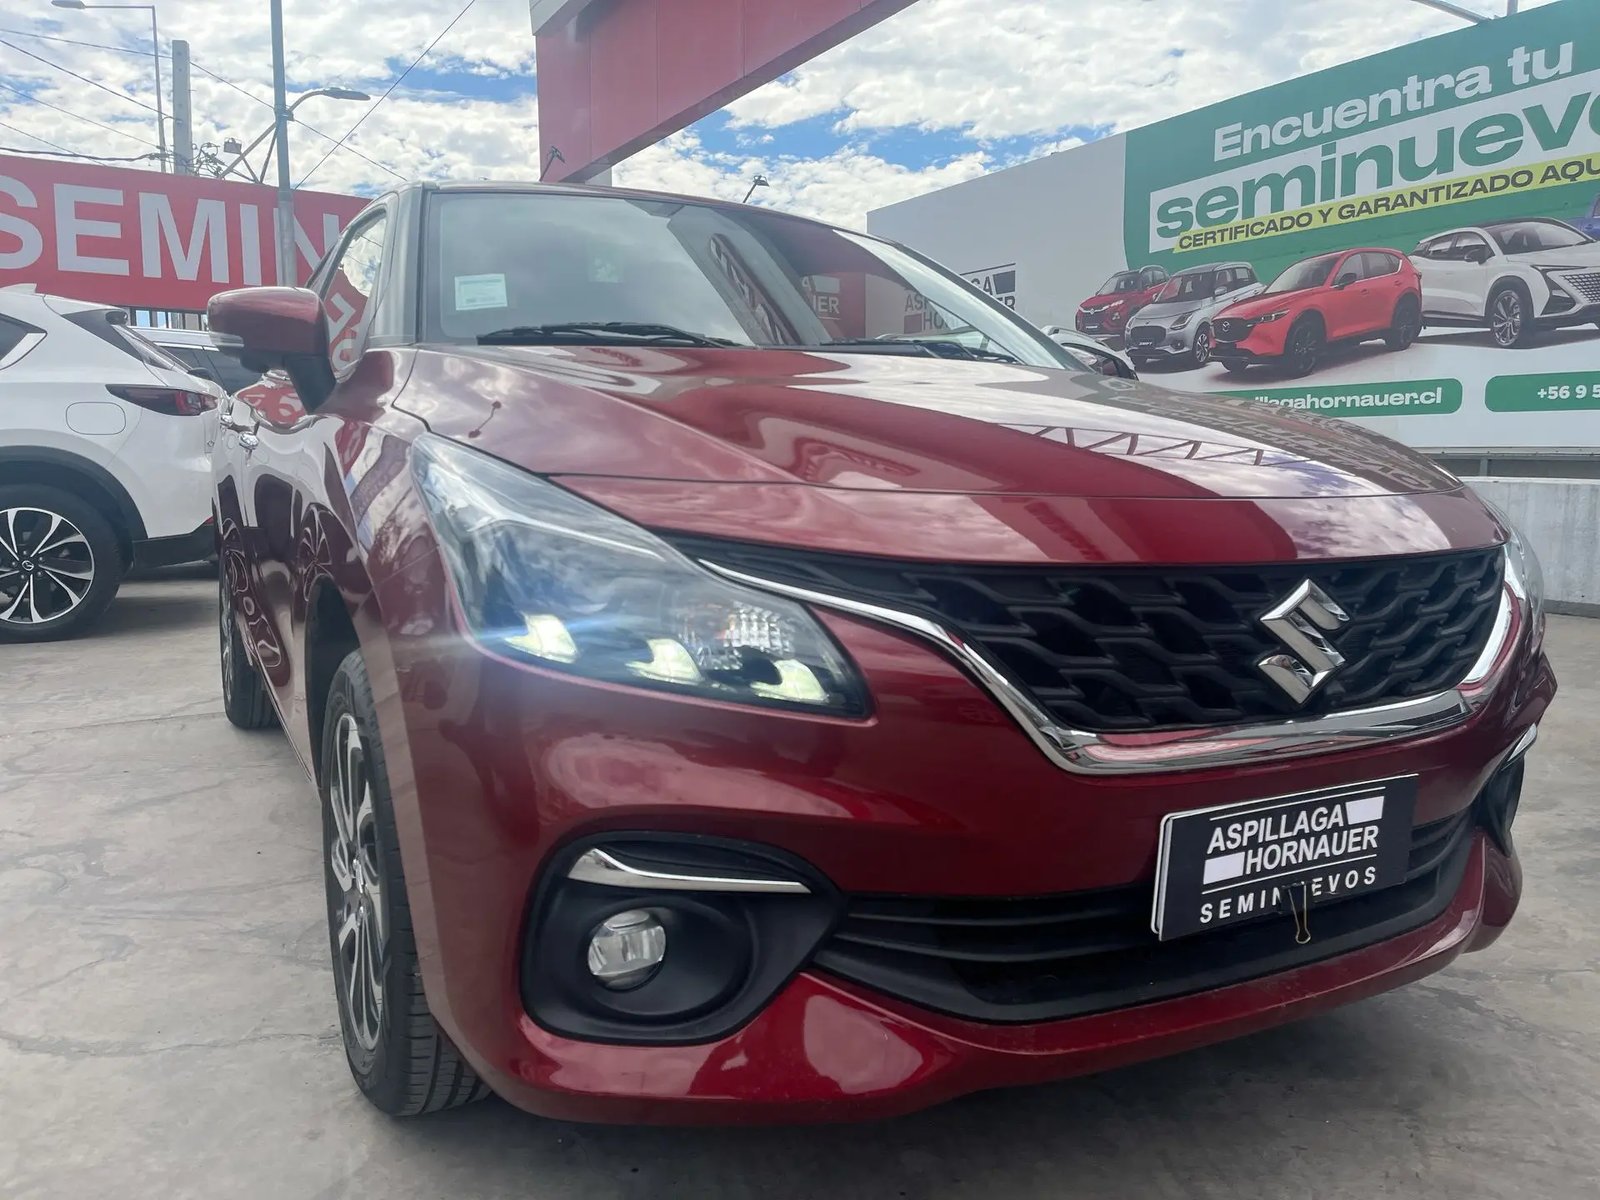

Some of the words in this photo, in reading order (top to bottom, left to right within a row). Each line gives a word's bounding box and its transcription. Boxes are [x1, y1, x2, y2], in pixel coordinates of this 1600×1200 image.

[1214, 65, 1492, 162] Encuentra
[1507, 41, 1573, 86] tu
[1156, 92, 1600, 239] seminuev
[1178, 211, 1312, 250] CERTIFICADO
[1318, 208, 1335, 224] Y
[1338, 169, 1533, 220] GARANTIZADO
[1537, 385, 1570, 400] +56
[1575, 384, 1587, 399] 9
[1206, 804, 1344, 855] ASPILLAGA
[1245, 825, 1378, 875] HORNAUER
[1200, 866, 1377, 924] SEMINEVOS
